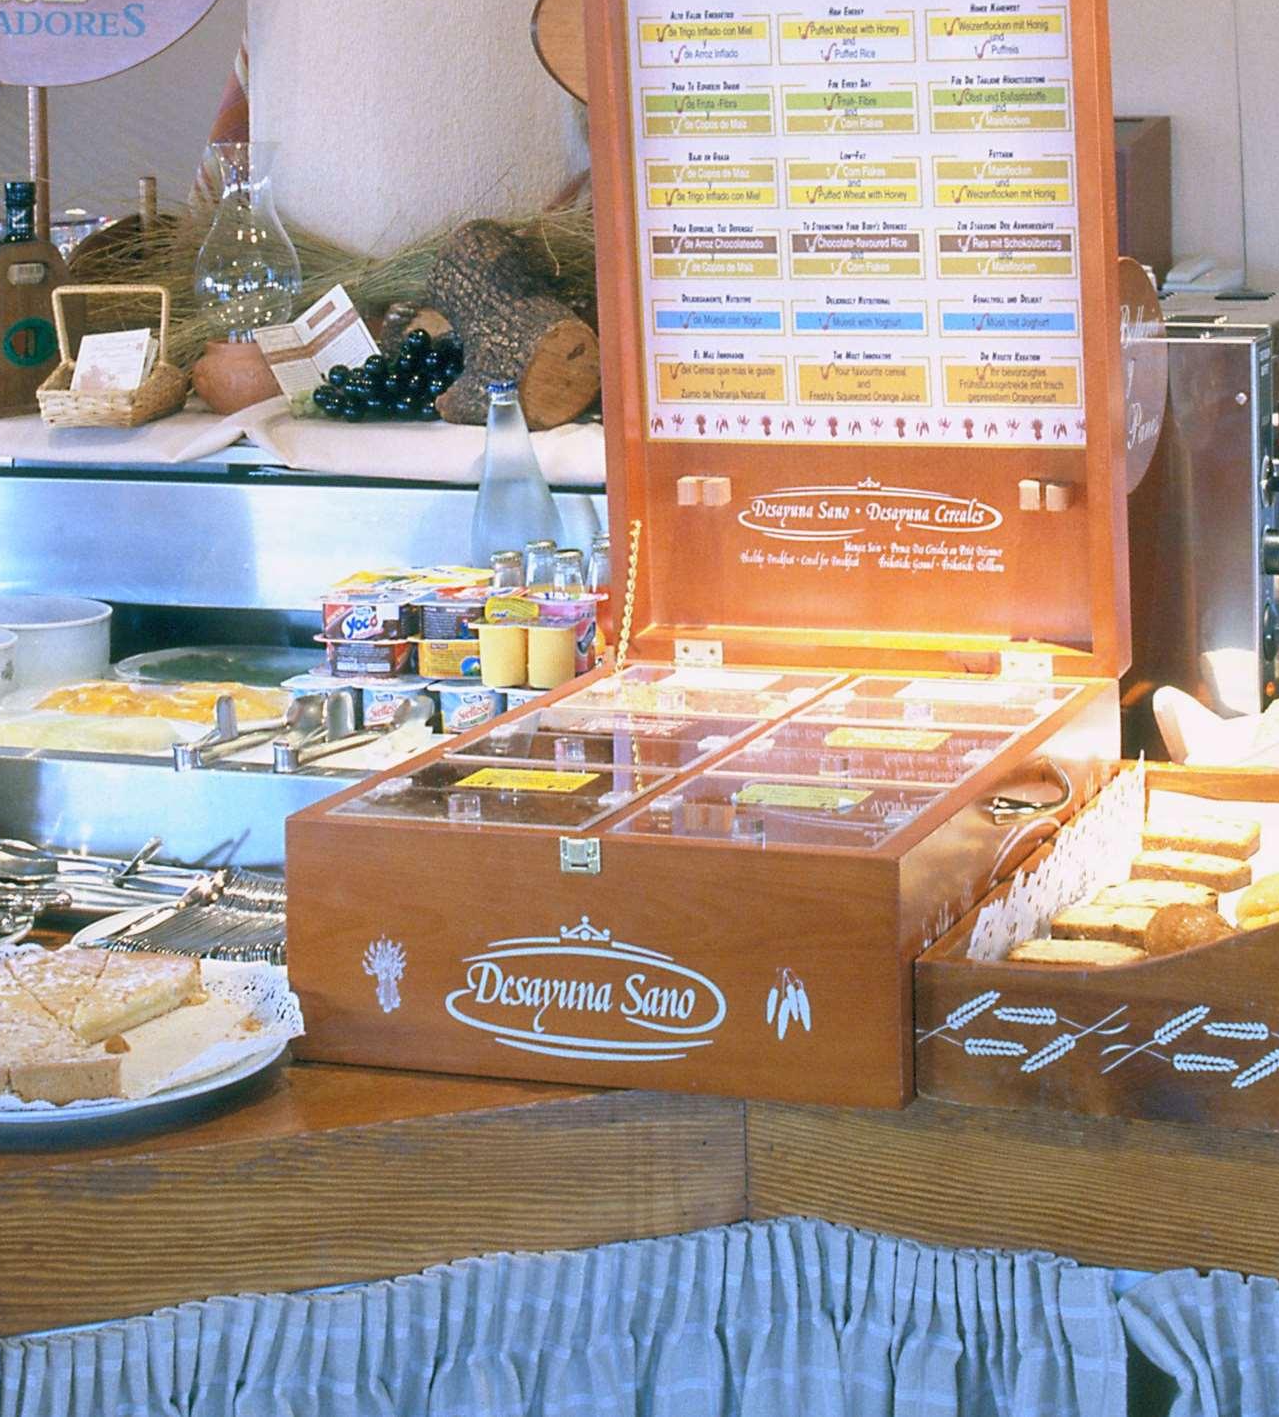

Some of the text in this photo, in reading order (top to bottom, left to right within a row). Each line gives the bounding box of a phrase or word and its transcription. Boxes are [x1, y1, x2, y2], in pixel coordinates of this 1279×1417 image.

[811, 24, 900, 35] Puffed Wheat with Honey
[959, 20, 1048, 32] Weizenflocken mit Honig
[668, 26, 753, 39] de Trigo Inflado con Miel
[990, 33, 1004, 41] und
[842, 37, 856, 46] and
[683, 49, 738, 59] de Arroz Inflado
[834, 49, 876, 58] Puffed Rice
[965, 93, 980, 102] Obst
[984, 93, 999, 102] und
[687, 100, 715, 109] de Fruta
[992, 104, 1006, 112] und
[995, 179, 1009, 187] und
[677, 192, 685, 200] de
[688, 191, 704, 203] Trigo
[746, 191, 760, 200] Miel
[818, 190, 907, 201] Puffed Wheat with Honey
[967, 189, 1056, 201] Weizenflocken mit Honig
[991, 238, 1002, 248] mit
[717, 368, 730, 377] que
[852, 367, 882, 376] favourite
[885, 368, 906, 376] cereal
[681, 389, 702, 399] Zumo
[713, 390, 739, 400] Naranja
[741, 391, 766, 399] Natural
[809, 392, 921, 403] Freshly Squeezed Orange Juice
[751, 498, 985, 531] Desayuna Sano Desayuna Cereales
[467, 960, 696, 1033] Desayuna Sano
